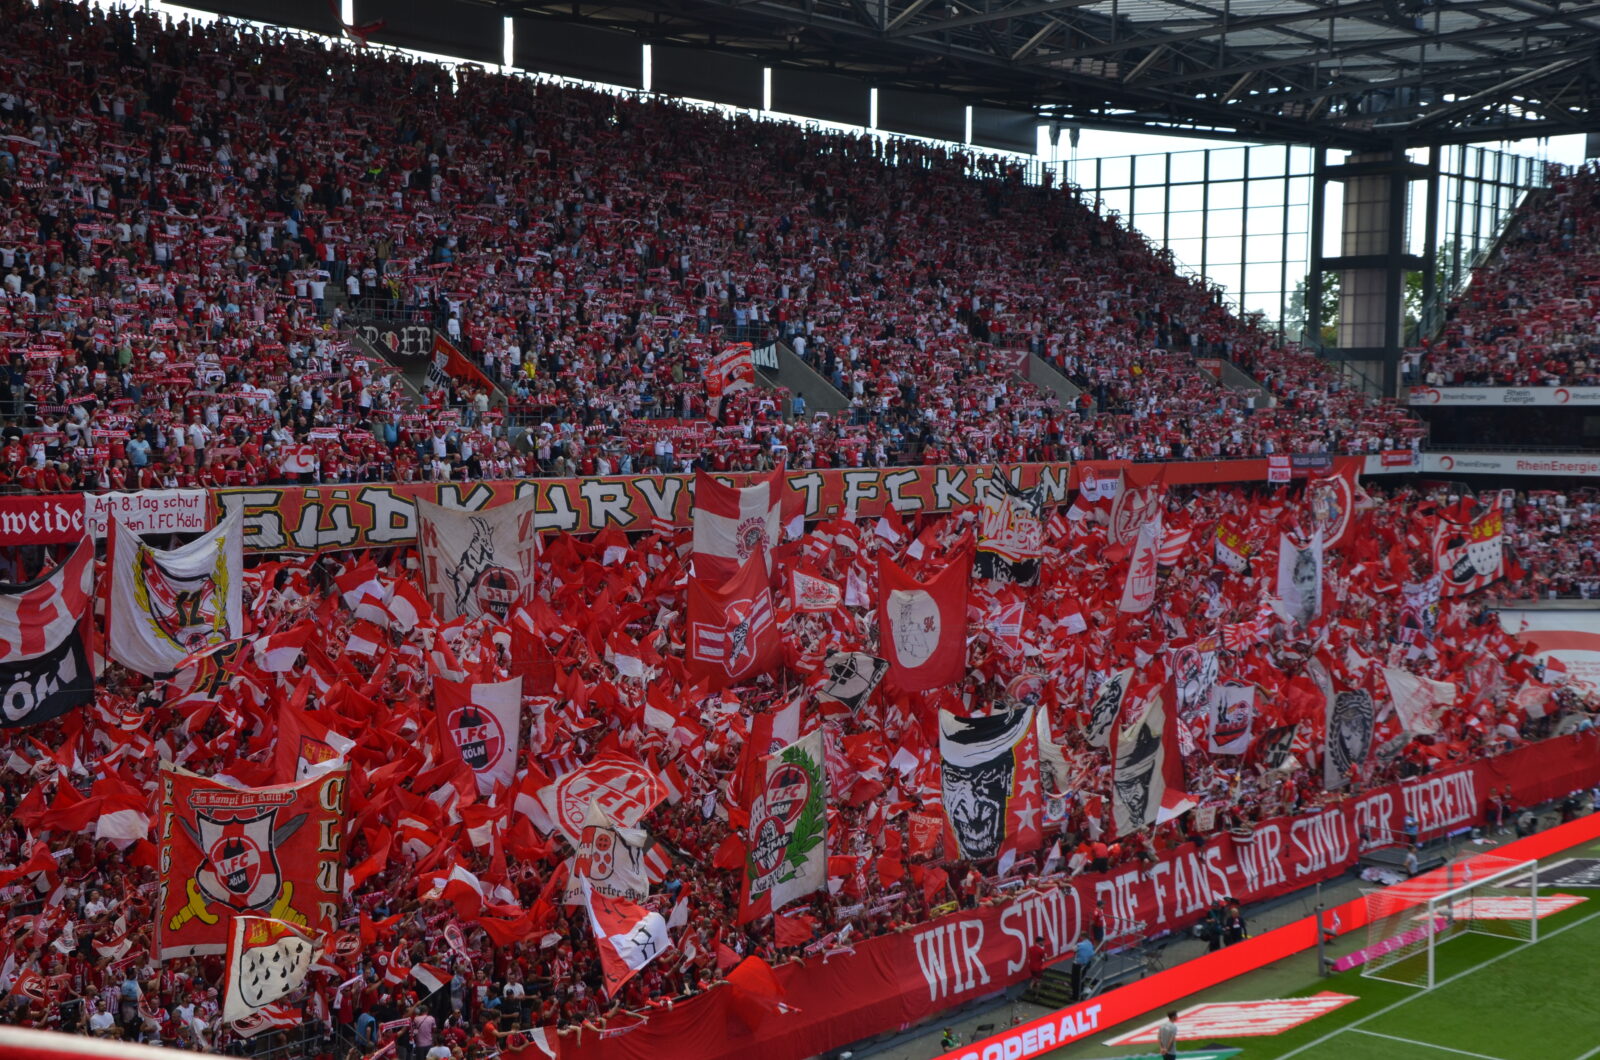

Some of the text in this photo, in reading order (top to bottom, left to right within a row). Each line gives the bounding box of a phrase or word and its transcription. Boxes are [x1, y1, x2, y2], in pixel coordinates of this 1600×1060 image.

[136, 495, 159, 512] Tag
[163, 492, 200, 508] schuf
[176, 512, 203, 528] Köln
[453, 725, 488, 747] 1.FC
[462, 743, 486, 760] KÖLN
[219, 852, 250, 876] 1.FC
[913, 919, 991, 1002] WIR
[1000, 886, 1082, 977] SIND
[1095, 869, 1147, 942] DIE
[1290, 808, 1350, 877] SIND
[1354, 792, 1394, 852] DER
[1402, 769, 1478, 833] VEREIN
[983, 1023, 1057, 1060] ODER
[1058, 1003, 1102, 1043] ALT
